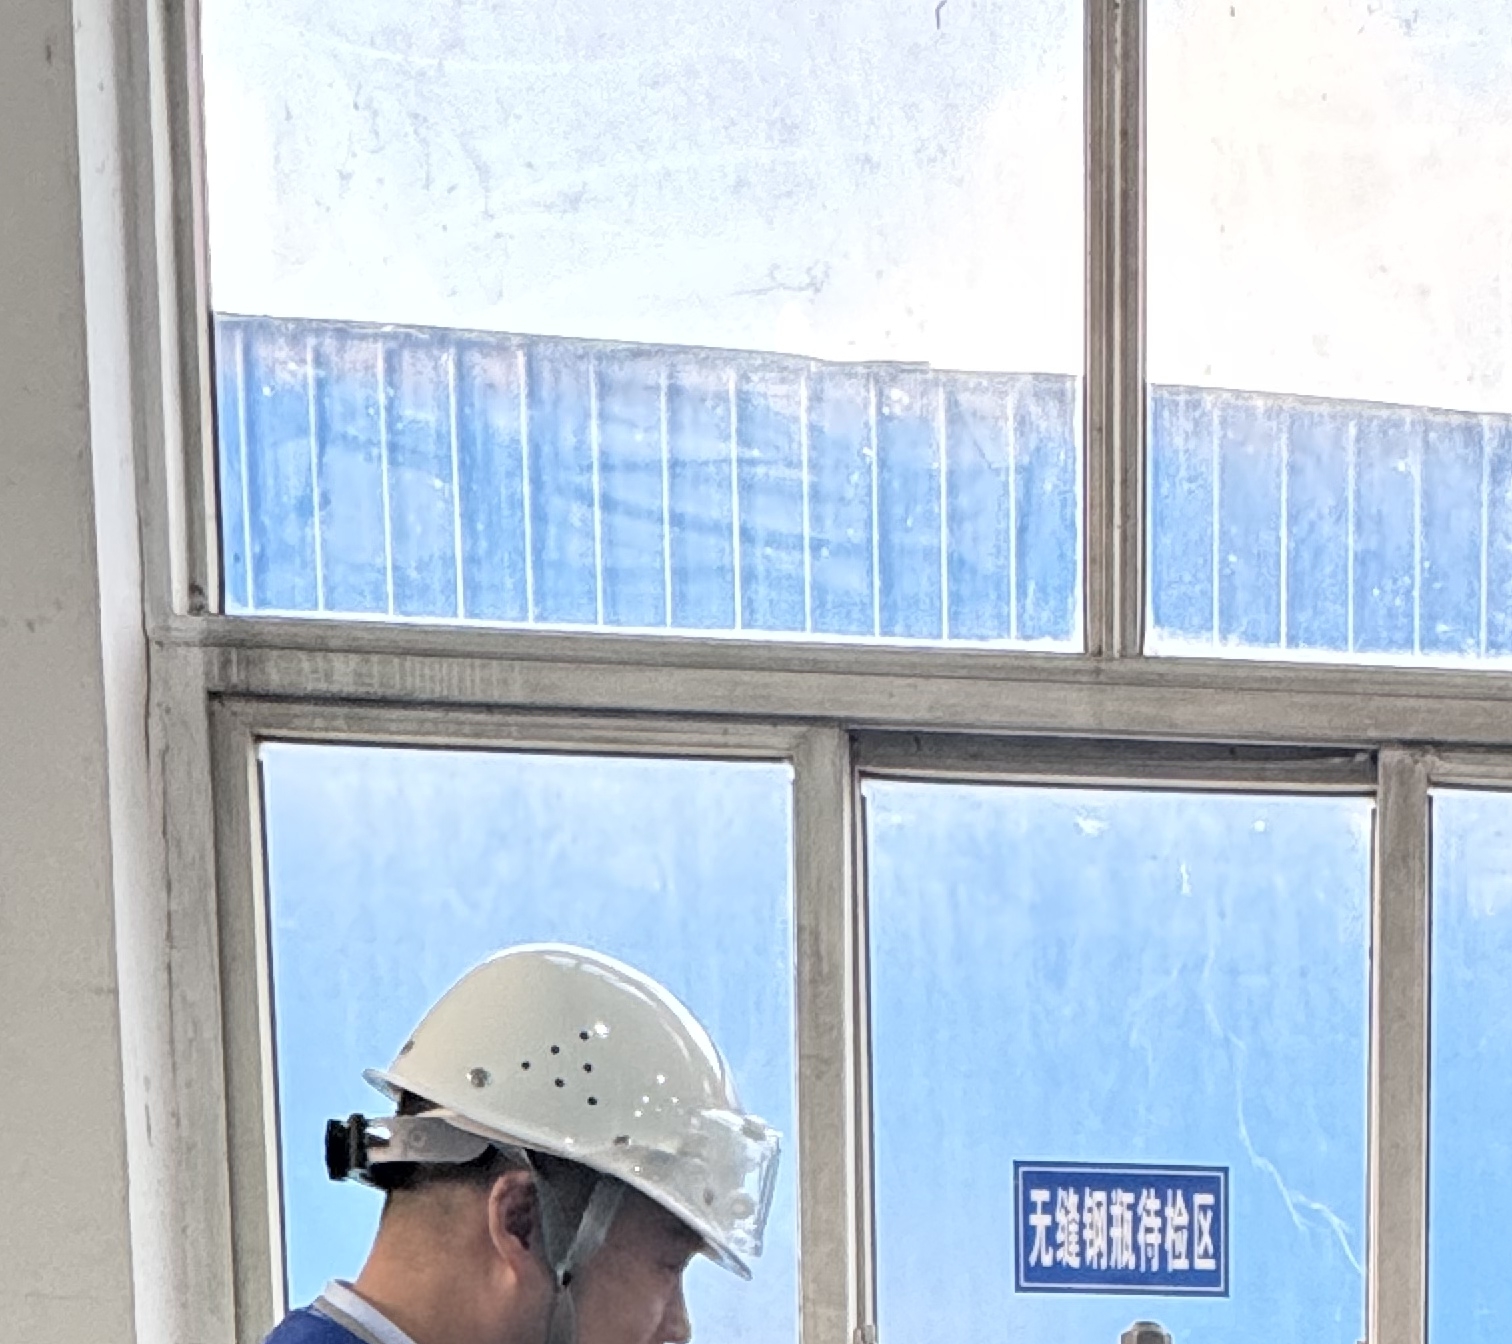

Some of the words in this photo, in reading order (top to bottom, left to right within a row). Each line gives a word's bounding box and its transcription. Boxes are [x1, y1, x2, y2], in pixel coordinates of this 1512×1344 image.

[1029, 1187, 1217, 1273] 无缝钢瓶待检区
